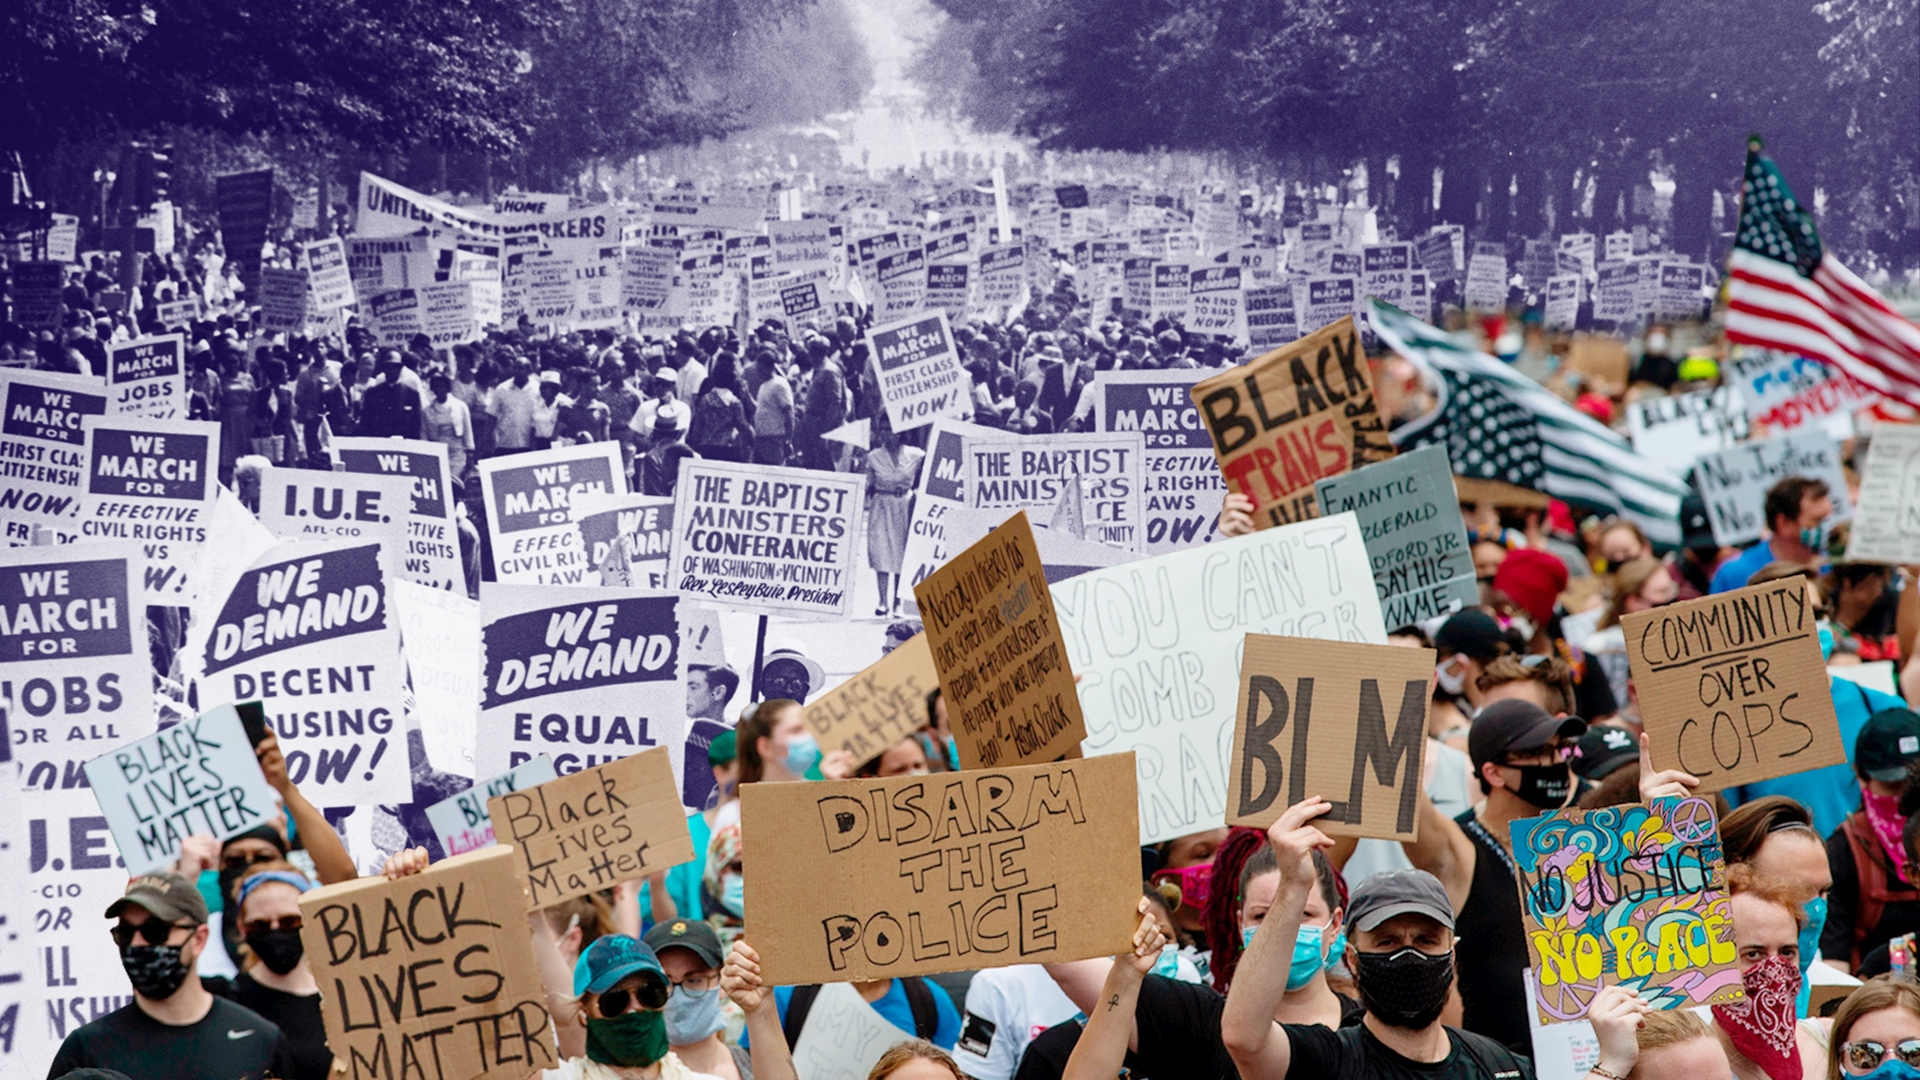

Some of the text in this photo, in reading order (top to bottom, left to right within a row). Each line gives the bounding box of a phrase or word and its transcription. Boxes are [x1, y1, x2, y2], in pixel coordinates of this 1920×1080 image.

[535, 304, 575, 318] NOW!
[882, 330, 943, 361] MARCH
[896, 325, 920, 340] WE
[117, 353, 173, 374] MARCH
[133, 345, 155, 359] WE
[902, 351, 927, 364] FOR
[133, 366, 156, 378] FOR
[884, 357, 955, 388] FIRST CLASS
[885, 371, 960, 402] CITIZENSHIP
[42, 391, 72, 410] WE
[117, 381, 174, 404] JOBS
[900, 388, 959, 423] NOW!
[1147, 387, 1185, 406] WE
[1201, 331, 1369, 457] BLACK
[11, 403, 84, 432] MARC
[36, 426, 69, 441] FOR
[1115, 408, 1206, 432] MARC
[0, 441, 46, 462] FIRST
[130, 435, 166, 456] WE
[1147, 433, 1189, 447] FOR
[0, 461, 80, 487] ITIZENSH
[97, 450, 198, 482] MARCH
[377, 454, 411, 474] WE
[533, 464, 572, 487] WE
[975, 449, 1131, 478] THE BAPTIST
[1224, 419, 1350, 513] TRANS
[0, 488, 81, 518] NOW!
[125, 481, 166, 496] FOR
[284, 484, 392, 525] I.U.E.
[694, 474, 849, 515] THE BAPTIST
[1147, 495, 1196, 511] AWS
[96, 502, 199, 524] EFFECTIVE
[617, 508, 659, 533] WE
[688, 506, 847, 540] MINISTERS
[1147, 511, 1222, 544] OW!
[82, 519, 207, 544] CIVIL RIGHTS
[303, 524, 362, 538] AFL-CIO
[691, 528, 839, 564] CONFERANCE
[500, 555, 553, 575] CIVIL
[683, 555, 842, 587] OF WASHINGTON VICINITY
[1416, 554, 1455, 583] HIS
[20, 569, 70, 597] WE
[257, 559, 324, 607] WE
[786, 585, 844, 607] President
[1051, 525, 1348, 667] YOU CAN'T
[1385, 586, 1452, 627] NAME
[213, 585, 379, 662] DEMAND
[545, 604, 619, 649] WE
[1640, 586, 1807, 667] COMMUNITY
[22, 638, 78, 656] FOR
[495, 633, 673, 696] DEMAND
[233, 664, 376, 700] DECENT
[1698, 657, 1776, 708] OVER
[806, 670, 889, 736] BLACK
[858, 673, 925, 729] LIVES
[1076, 650, 1216, 750] COMB
[66, 723, 120, 742] ALL
[514, 712, 657, 746] EQUAL
[1677, 691, 1815, 780] COPS
[115, 717, 222, 785] BLACK
[288, 738, 388, 785] OW!
[1237, 674, 1428, 834] BLM
[126, 754, 224, 824] LIVES
[501, 767, 632, 842] Black
[136, 786, 261, 863] MATTER
[817, 768, 1087, 855] DISARM
[520, 814, 634, 873] Lives
[527, 840, 652, 906] Matter
[899, 834, 1030, 894] THE
[1517, 843, 1726, 916] NO JUSTICE
[313, 882, 503, 967] BLACK
[821, 882, 1059, 972] POLICE
[1532, 932, 1604, 987] NO
[334, 943, 506, 1035] LIVES
[349, 999, 553, 1080] MATTER
